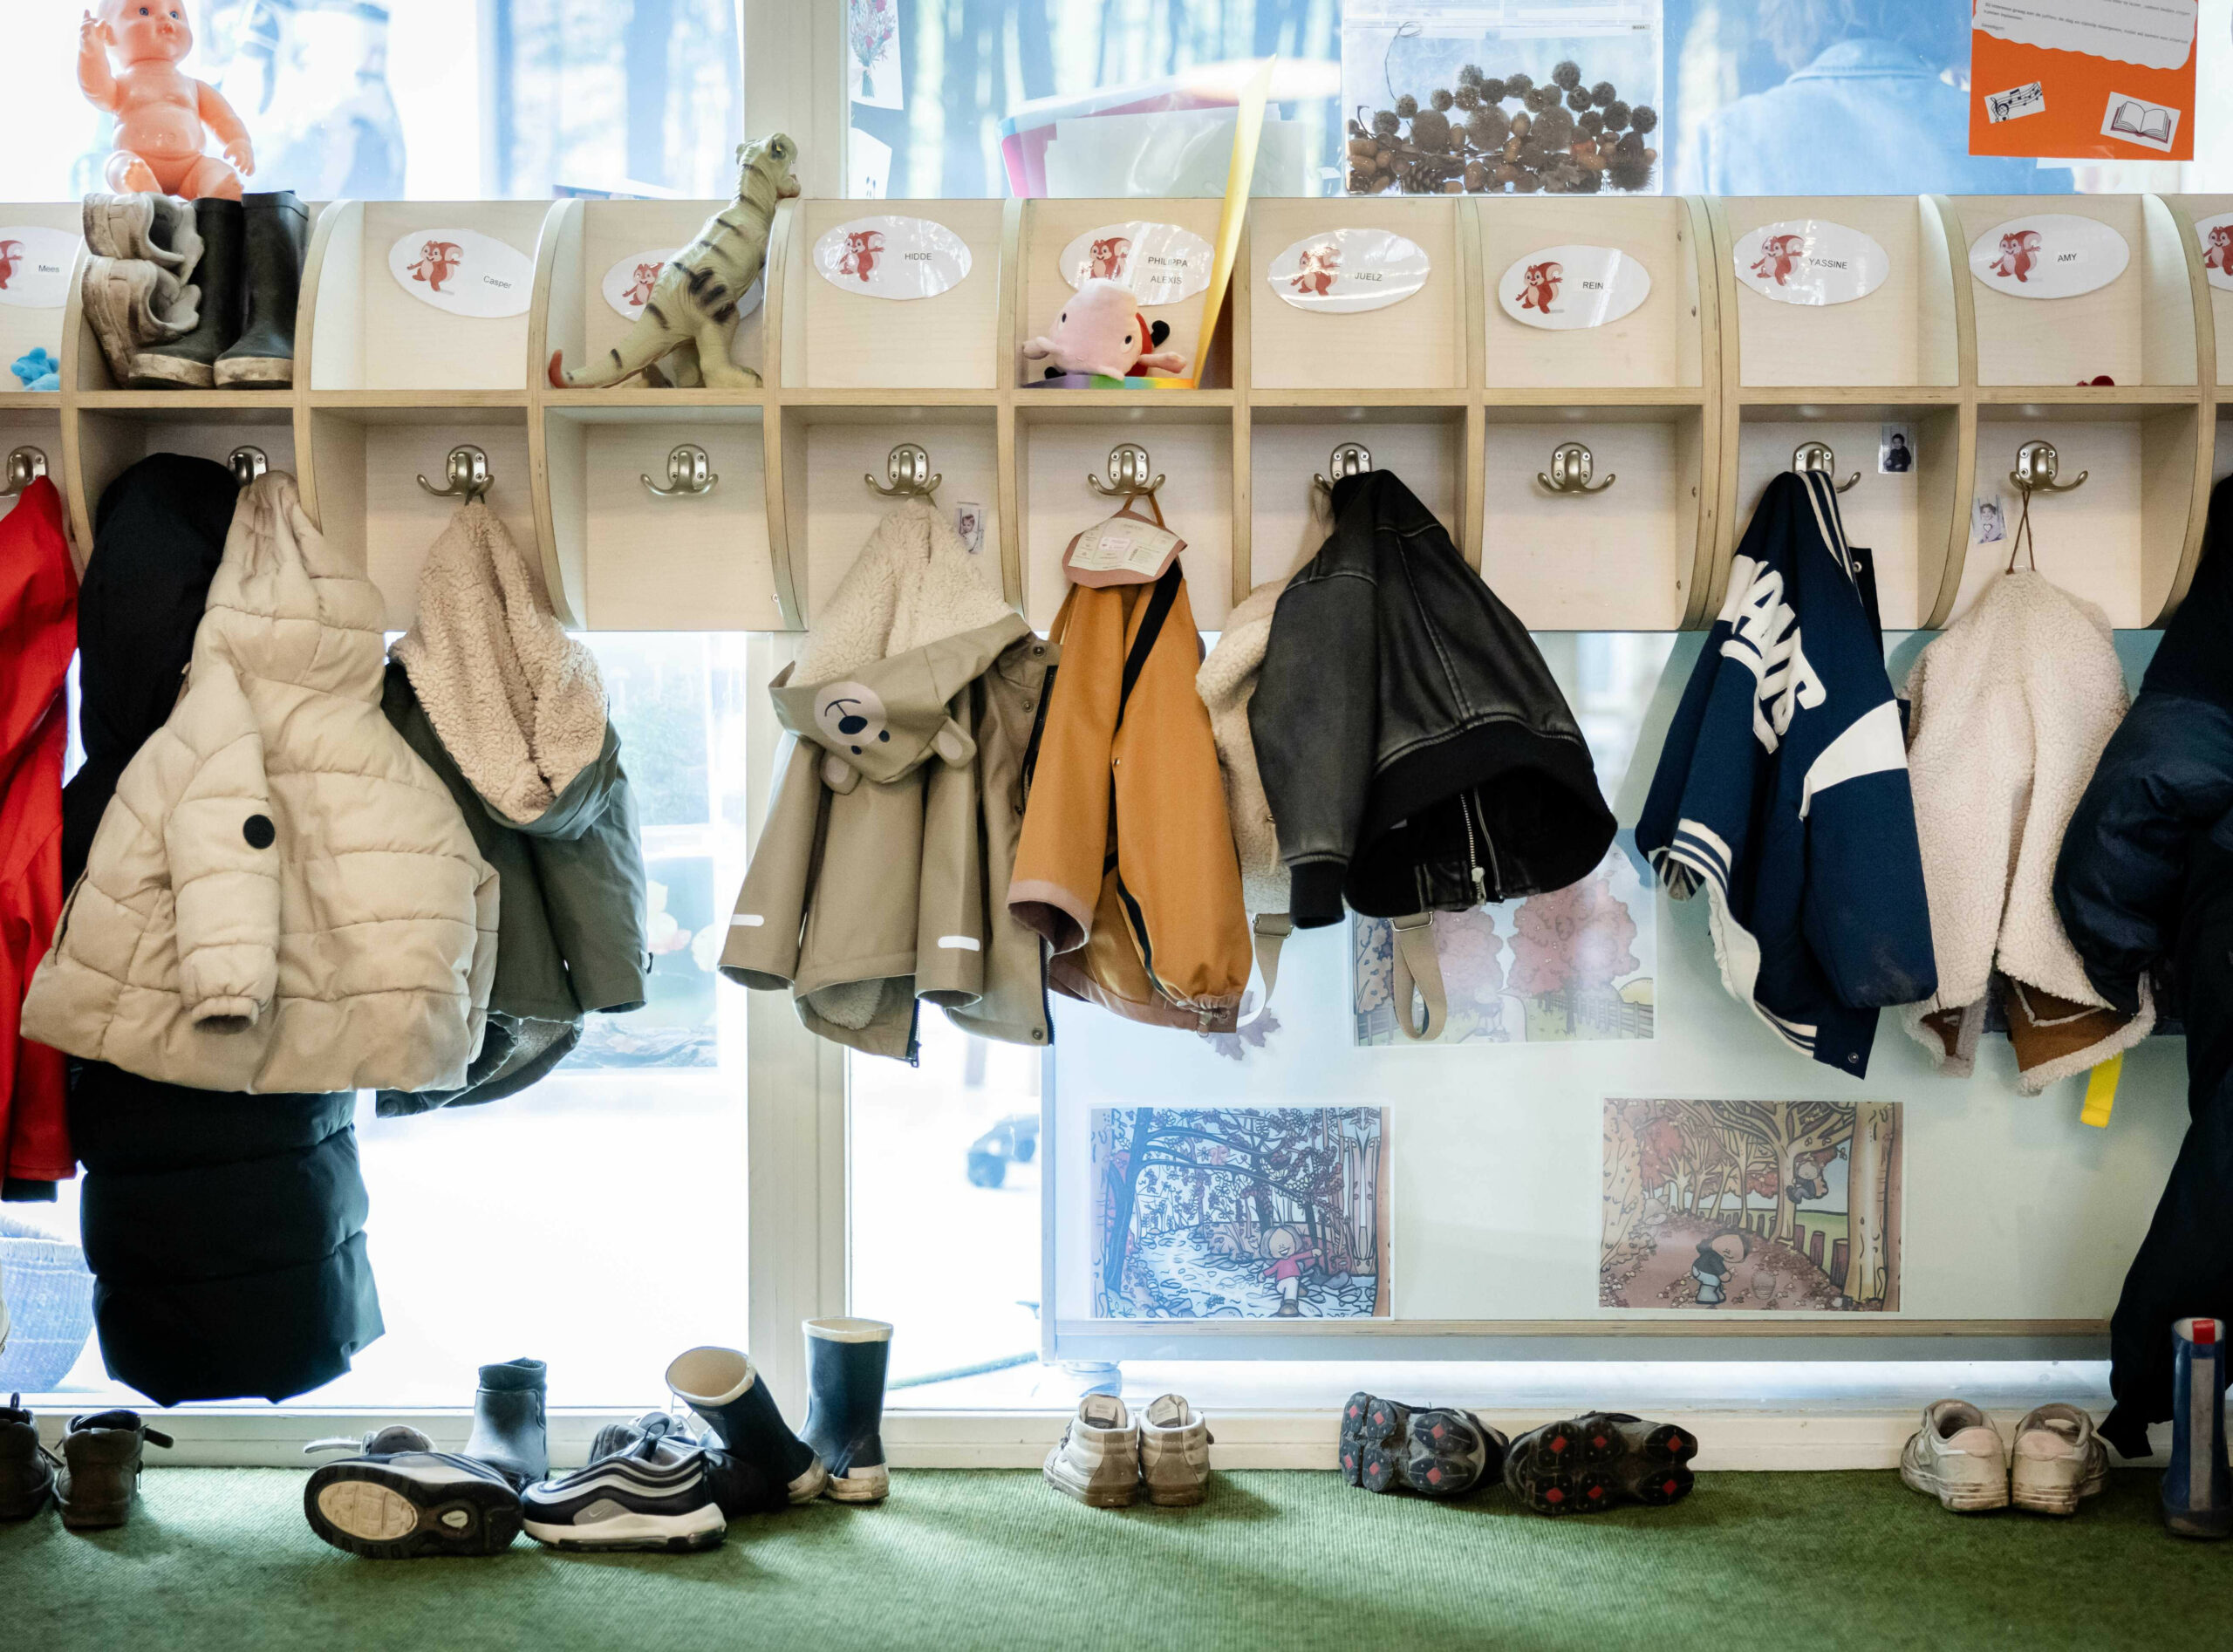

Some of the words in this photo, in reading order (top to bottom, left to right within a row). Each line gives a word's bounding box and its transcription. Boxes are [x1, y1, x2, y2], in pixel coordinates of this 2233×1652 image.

[905, 252, 932, 261] HIDDE
[2057, 253, 2077, 263] AMY
[38, 264, 59, 273] Mees
[1809, 258, 1847, 270] YASSINE
[1150, 275, 1182, 284] ALEXIS
[1355, 272, 1383, 282] JUELZ
[483, 275, 512, 290] Casper
[1582, 281, 1604, 290] REIN
